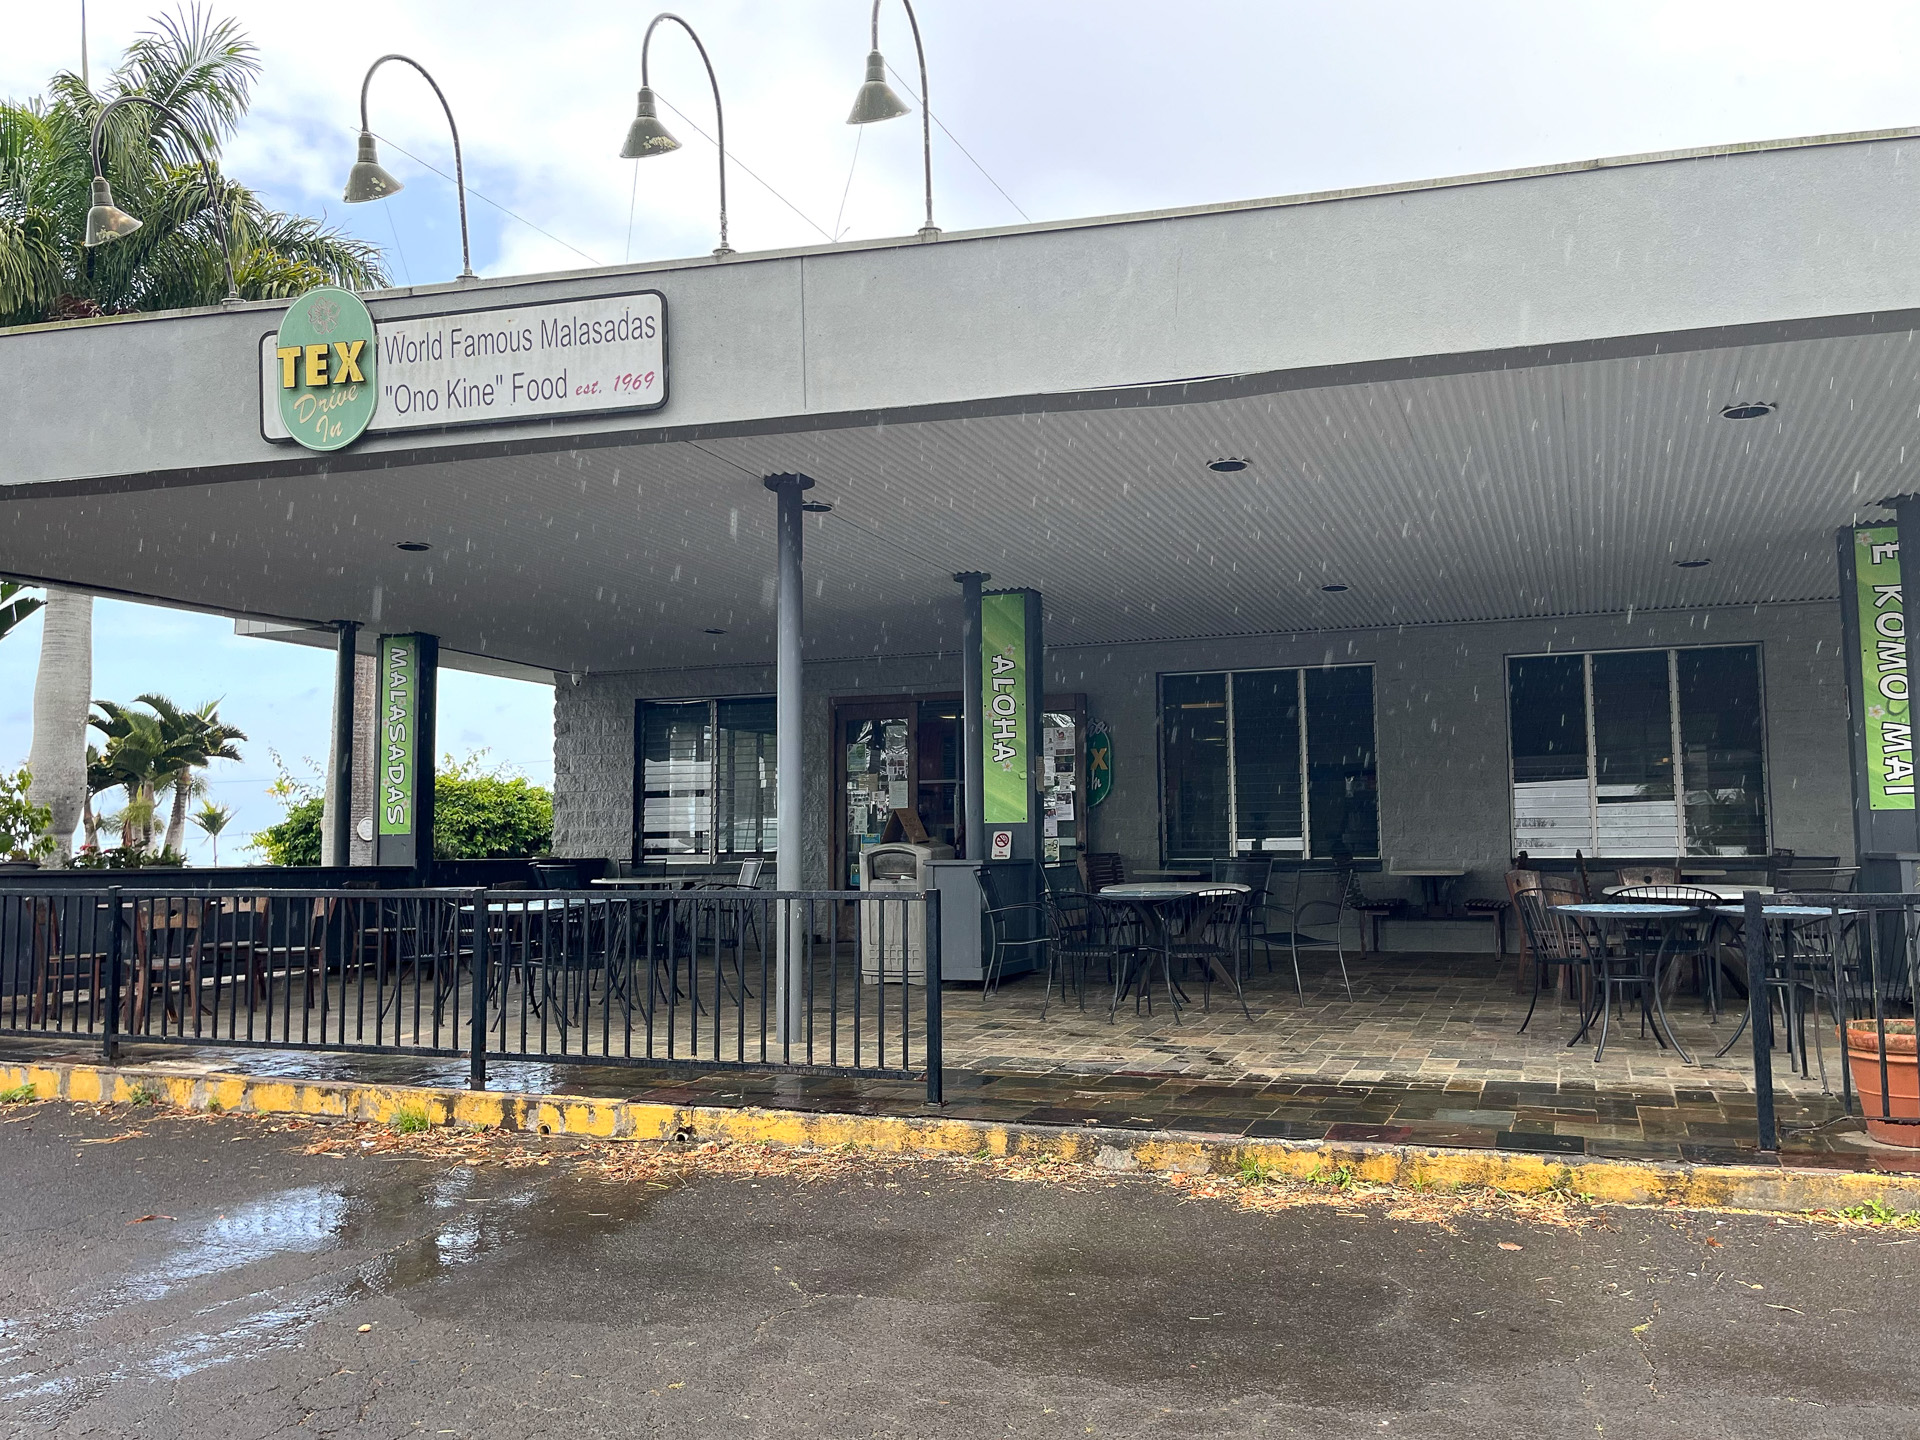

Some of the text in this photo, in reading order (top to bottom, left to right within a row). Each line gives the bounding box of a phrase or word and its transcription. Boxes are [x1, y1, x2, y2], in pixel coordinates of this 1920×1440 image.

[385, 310, 656, 365] World Famous Malasadas
[277, 340, 367, 389] TEX
[294, 384, 358, 423] Drive
[385, 368, 656, 416] "Ono Kine" Food est. 1969
[315, 417, 343, 443] In
[1871, 541, 1915, 795] E KOMO MAI
[991, 655, 1016, 763] ALOHA
[387, 648, 408, 825] MALASADAS
